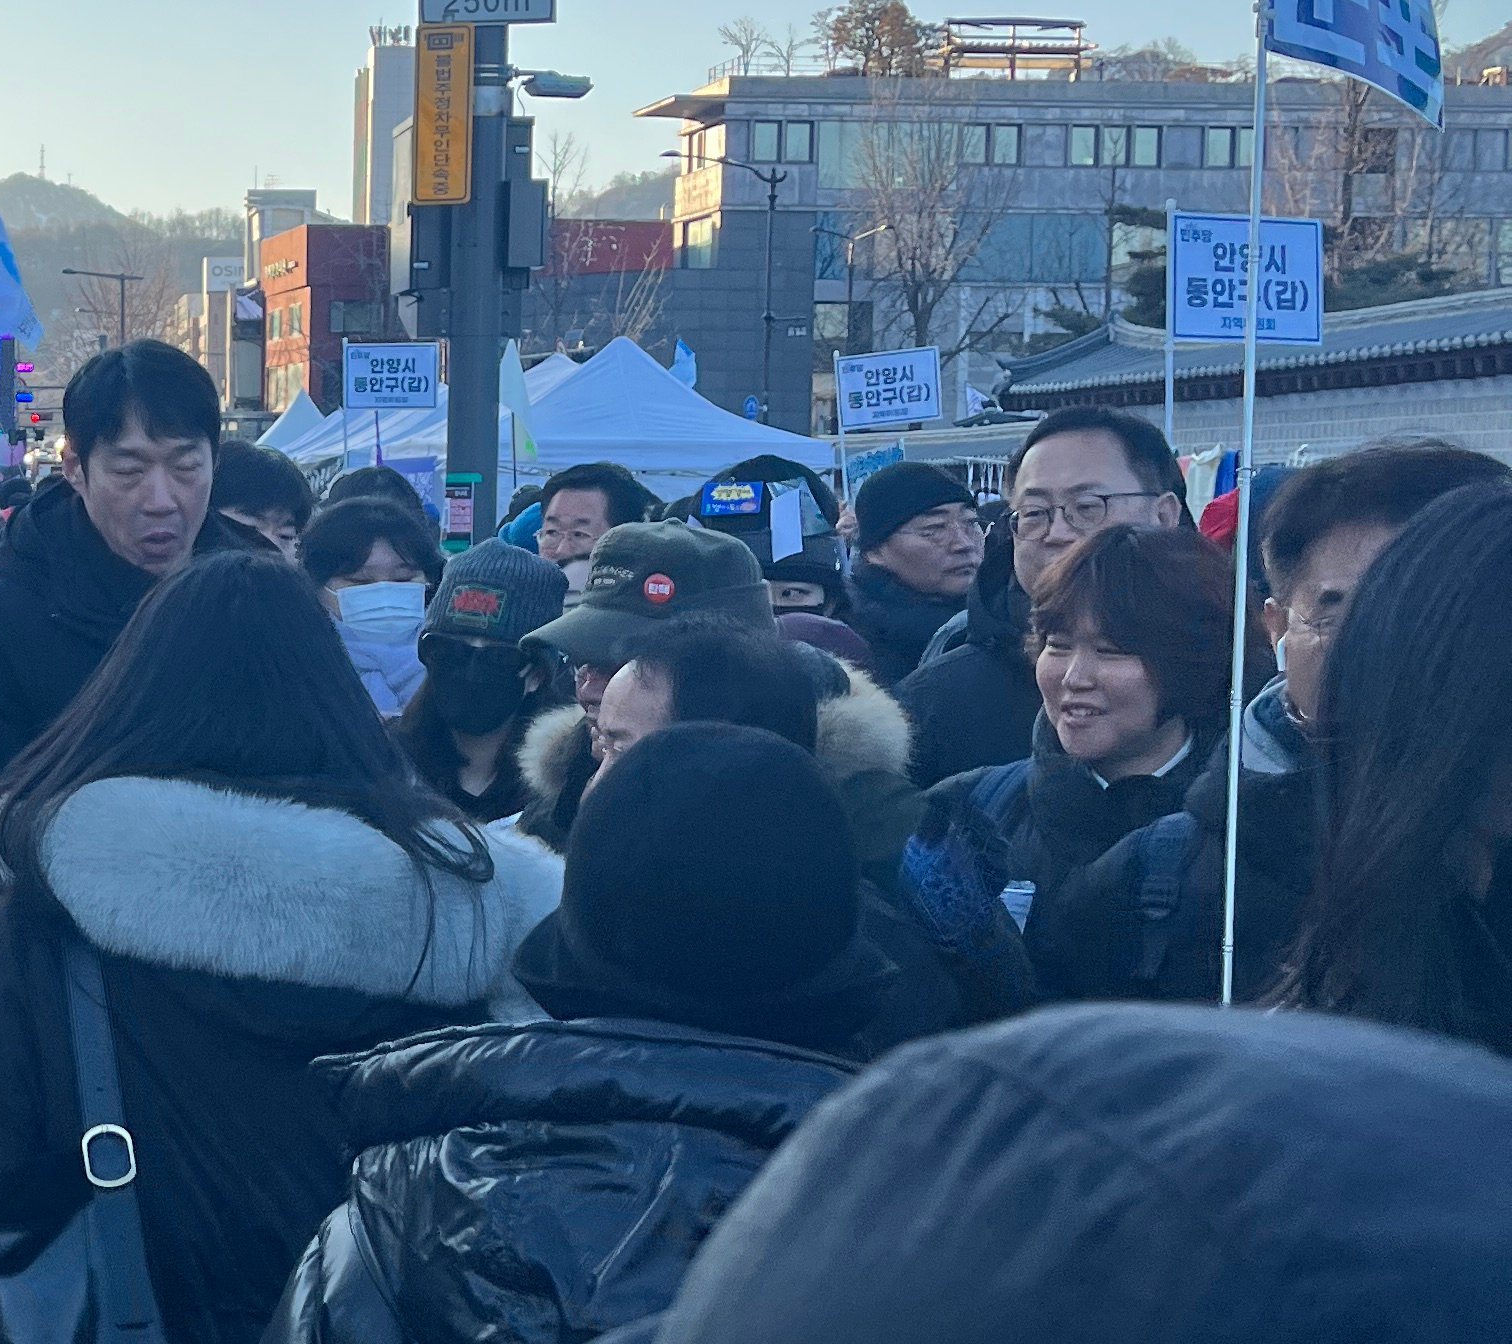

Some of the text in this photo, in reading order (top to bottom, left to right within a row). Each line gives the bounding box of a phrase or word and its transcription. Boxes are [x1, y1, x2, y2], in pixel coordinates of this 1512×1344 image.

[1220, 316, 1276, 331] 지역원회
[369, 357, 416, 374] 안양시
[864, 364, 915, 387] 안양시
[848, 383, 931, 409] 동안구(갑)
